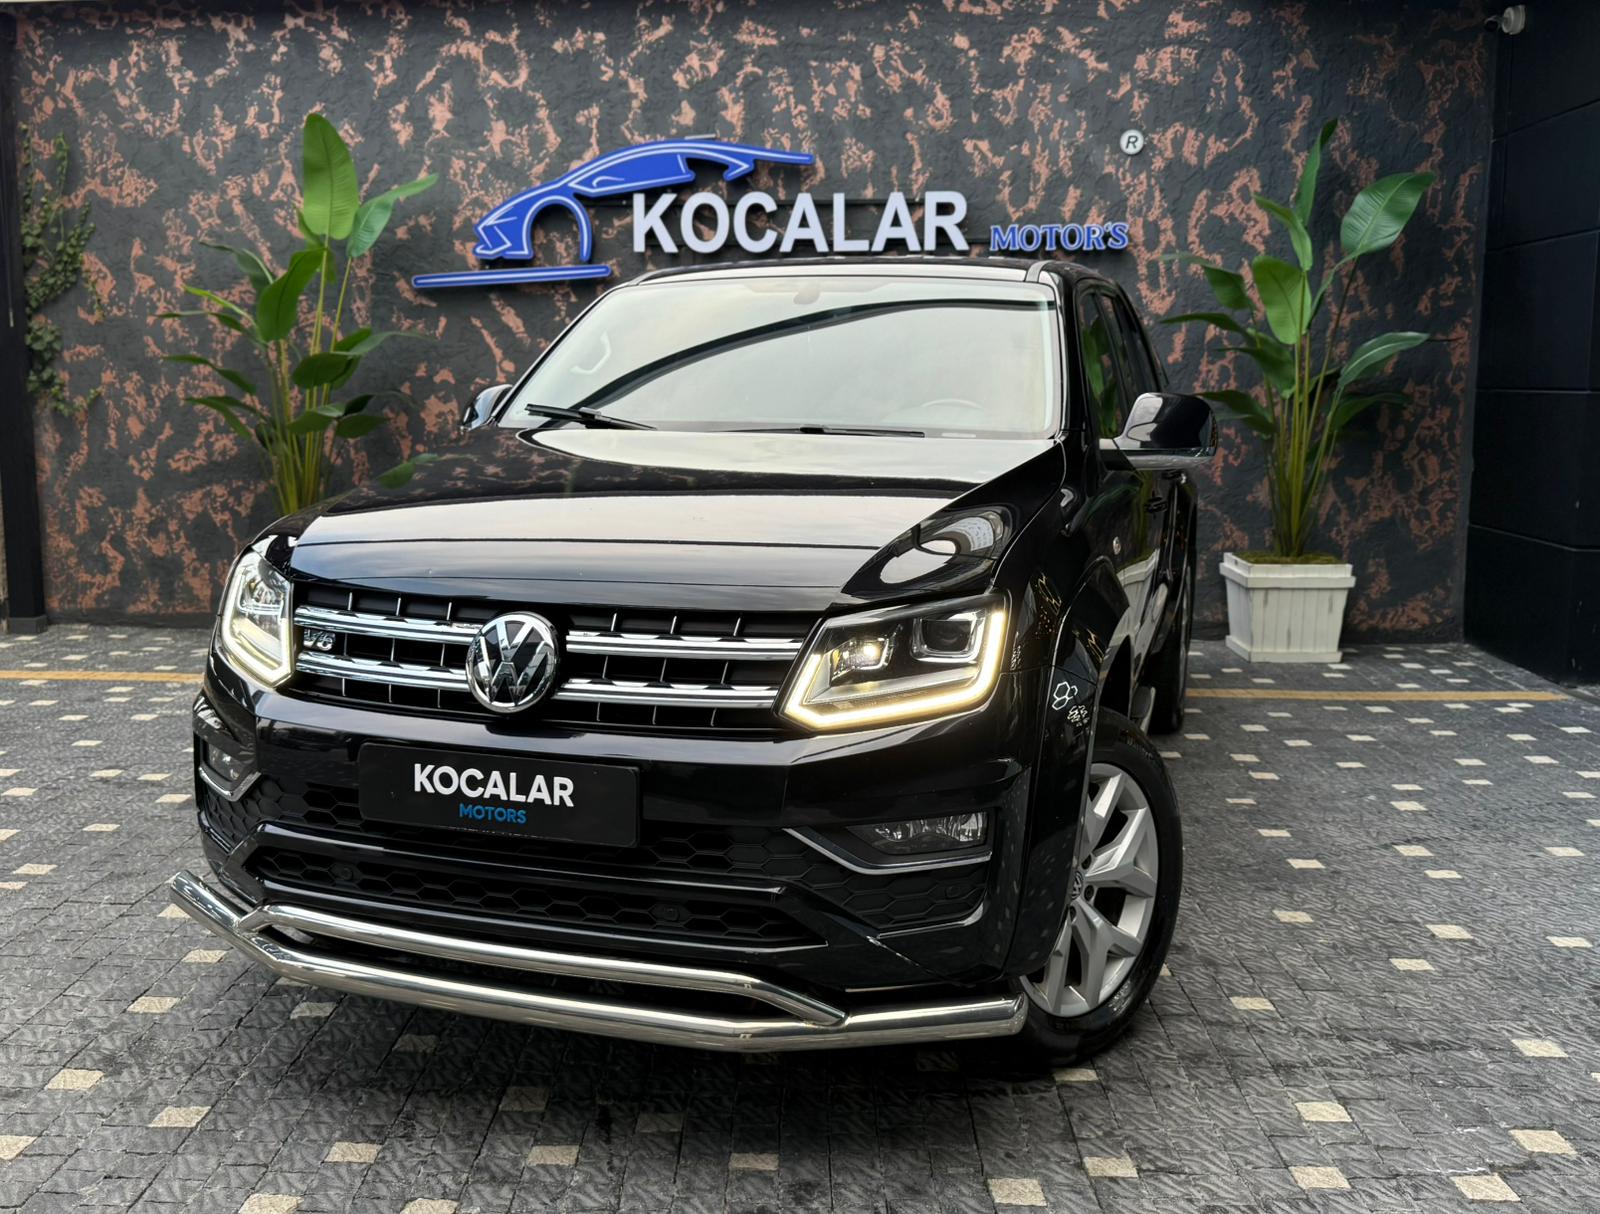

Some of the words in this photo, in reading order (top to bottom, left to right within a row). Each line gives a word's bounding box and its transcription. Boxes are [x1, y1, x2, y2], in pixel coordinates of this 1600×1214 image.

[632, 190, 970, 254] KOCALAR
[989, 221, 1130, 251] MOTOR'S
[303, 629, 335, 652] V6
[413, 762, 575, 808] KOCALAR
[458, 802, 528, 825] MOTORS
